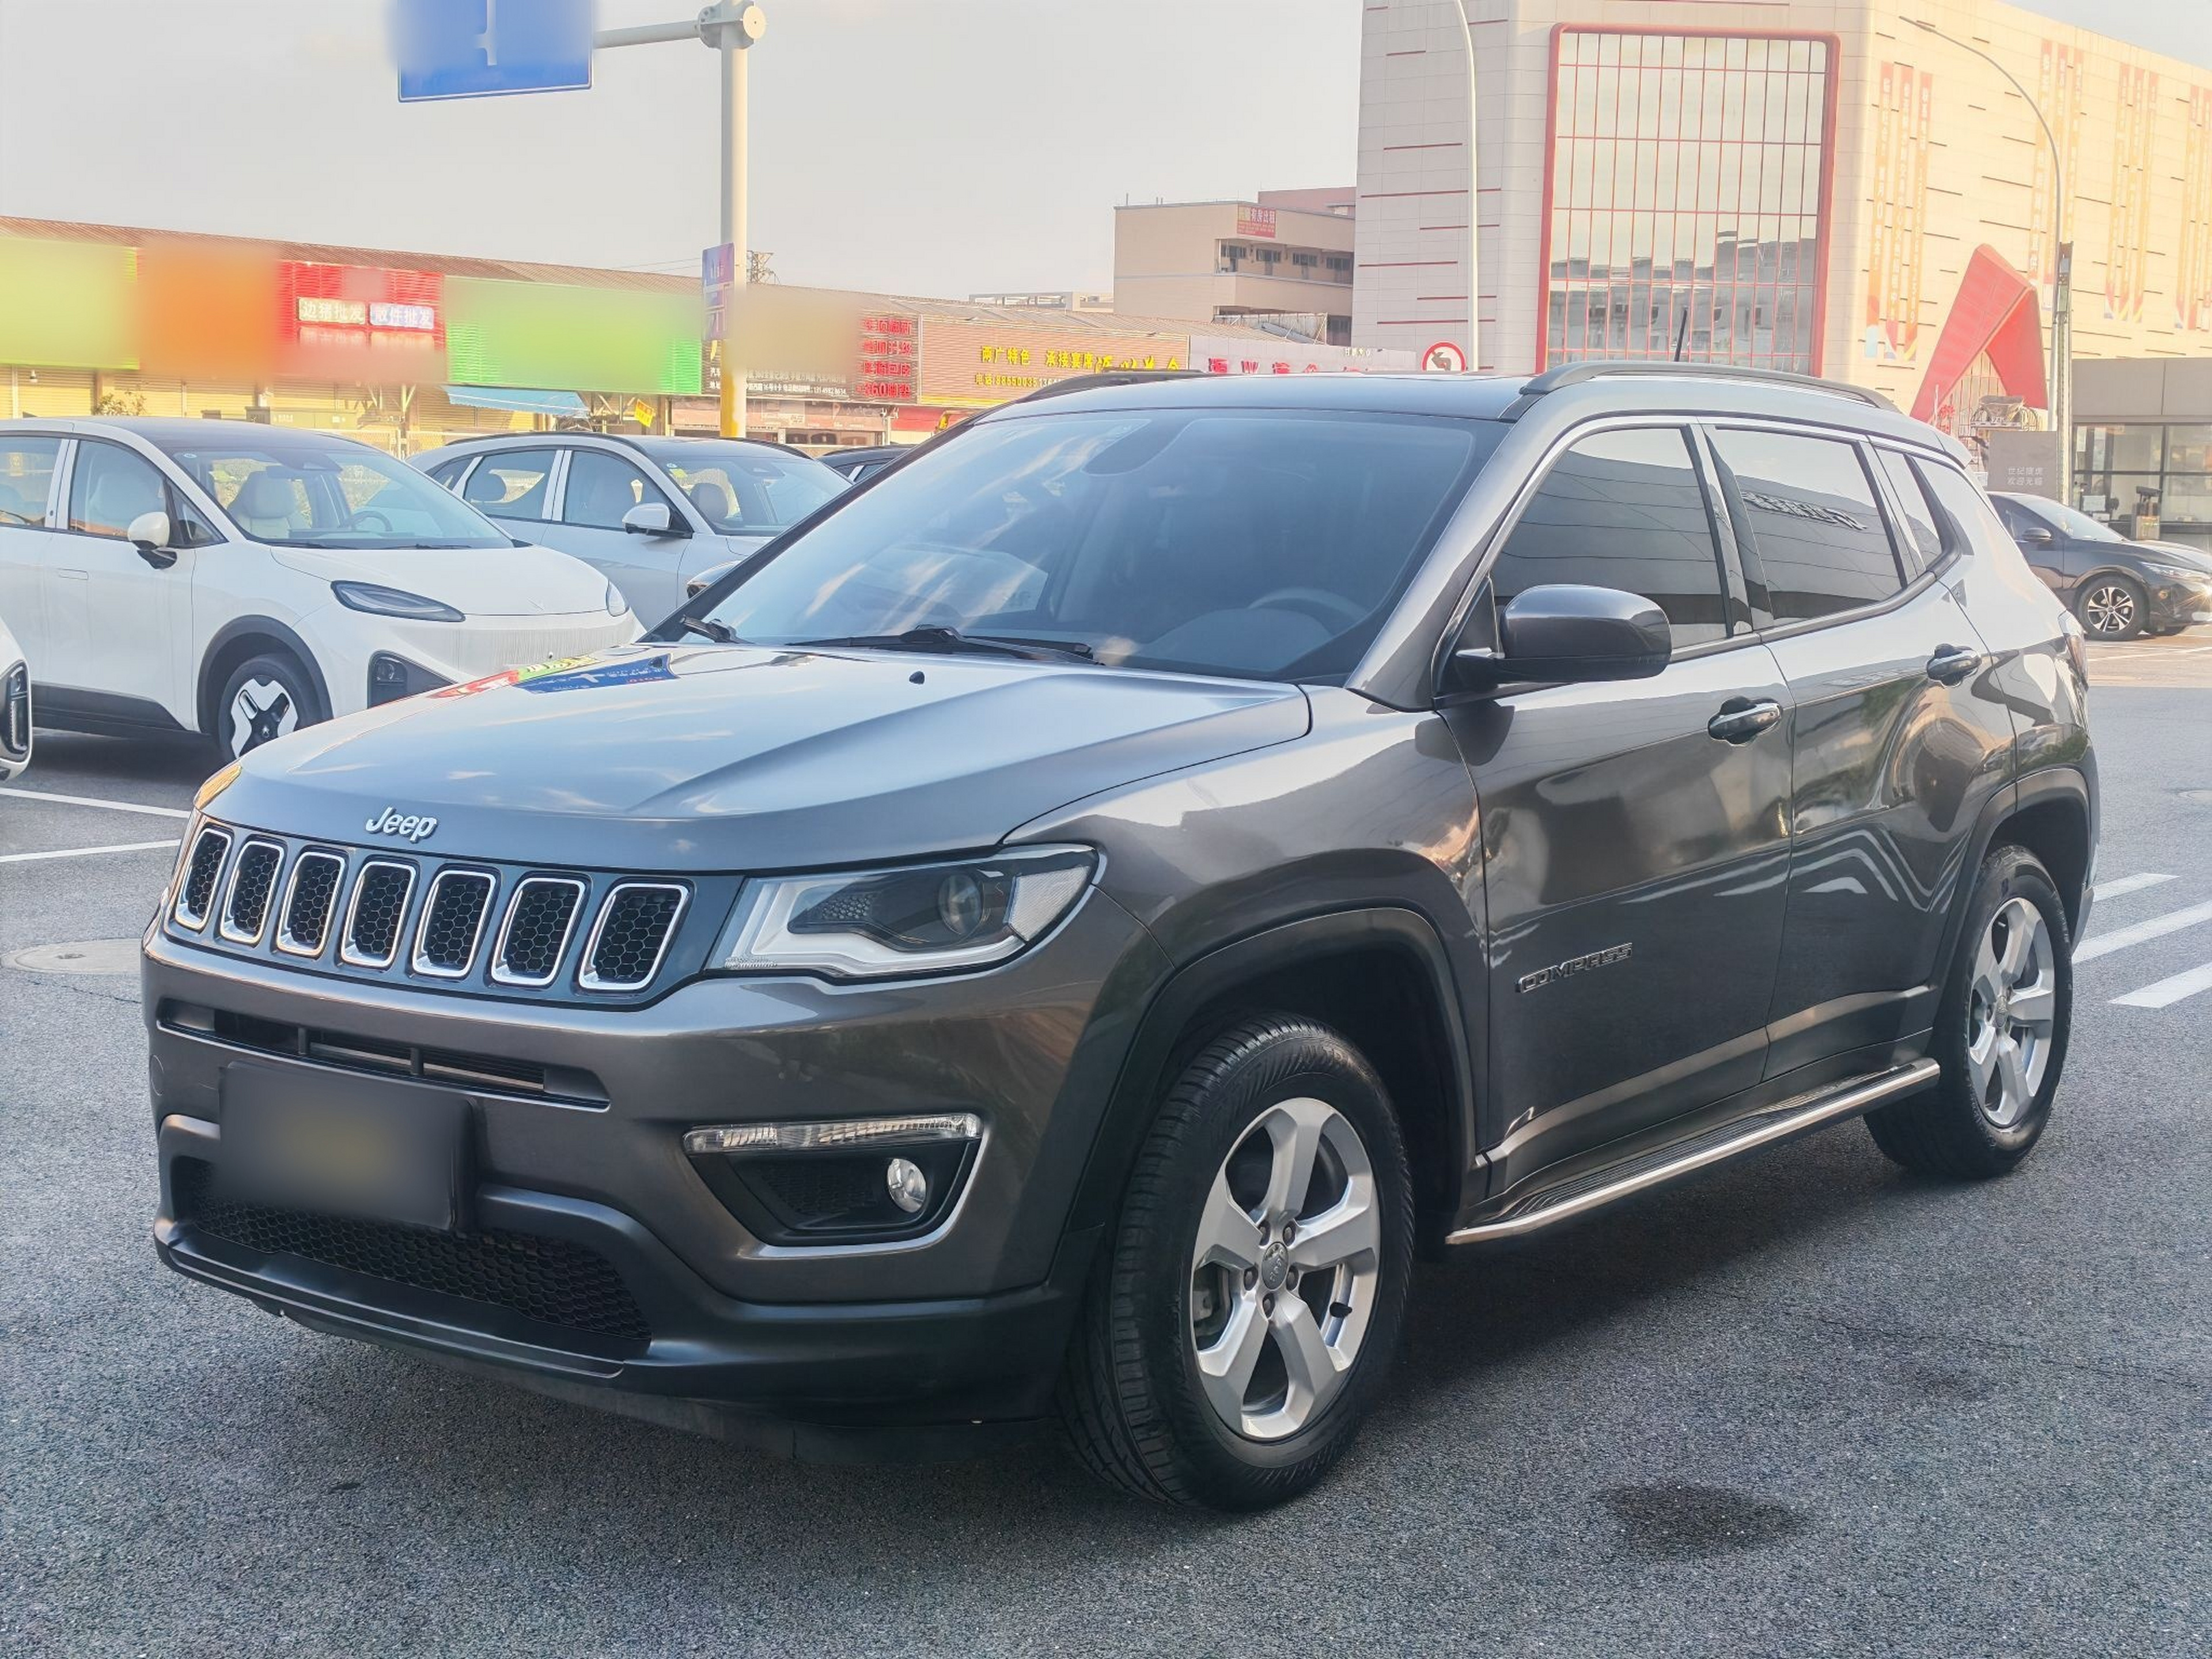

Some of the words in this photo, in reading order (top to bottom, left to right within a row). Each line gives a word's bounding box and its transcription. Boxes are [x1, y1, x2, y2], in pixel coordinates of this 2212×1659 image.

[982, 346, 1031, 365] 两广特色
[365, 806, 438, 843] Jeep
[1517, 942, 1633, 993] COMPASS
